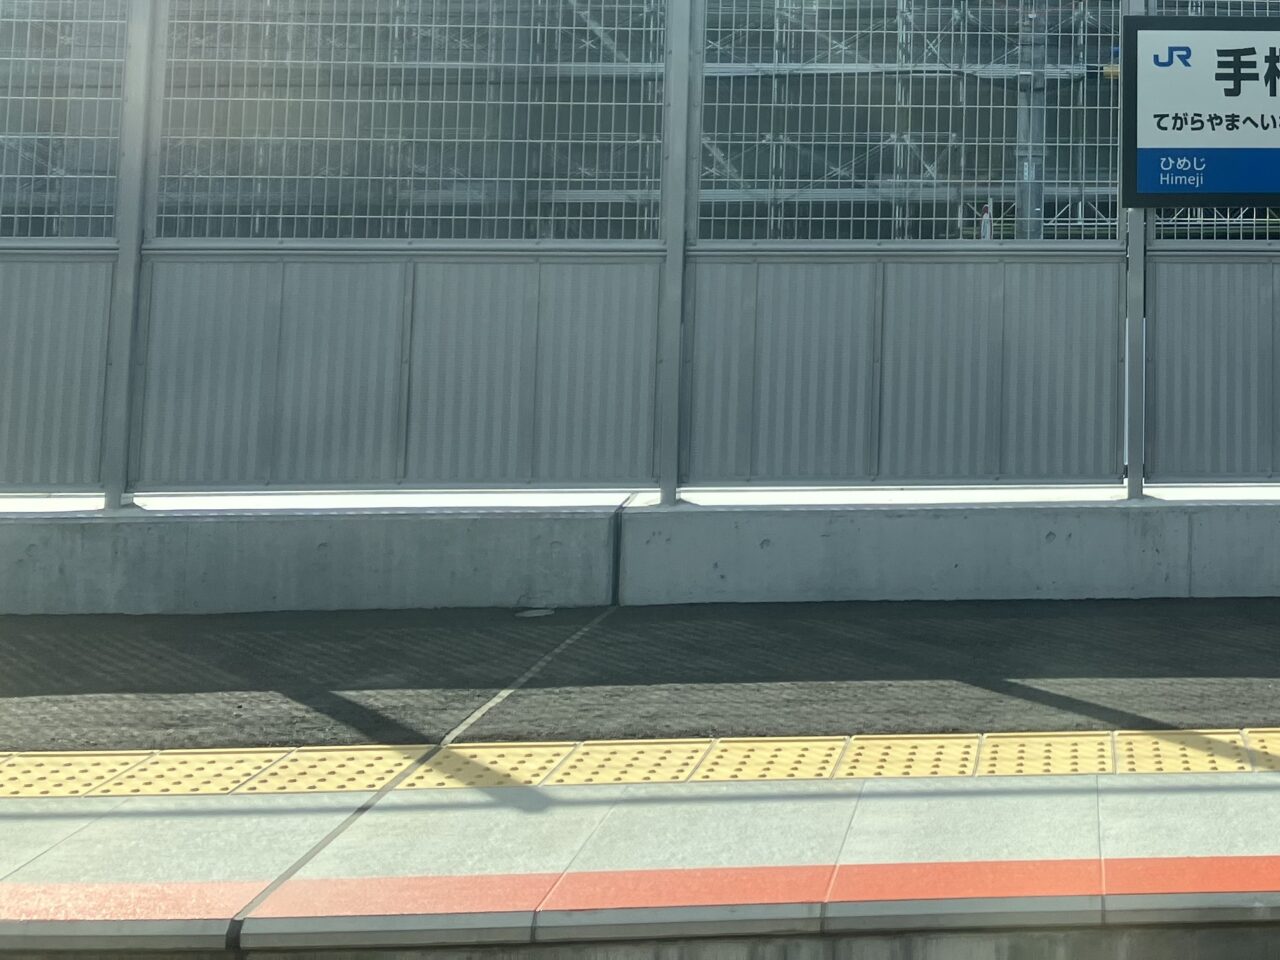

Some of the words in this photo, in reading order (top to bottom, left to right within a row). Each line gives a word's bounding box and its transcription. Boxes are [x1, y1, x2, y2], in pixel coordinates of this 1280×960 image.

[1153, 46, 1192, 68] JR
[1160, 156, 1206, 171] ひめじ
[1160, 172, 1204, 188] Himeji
